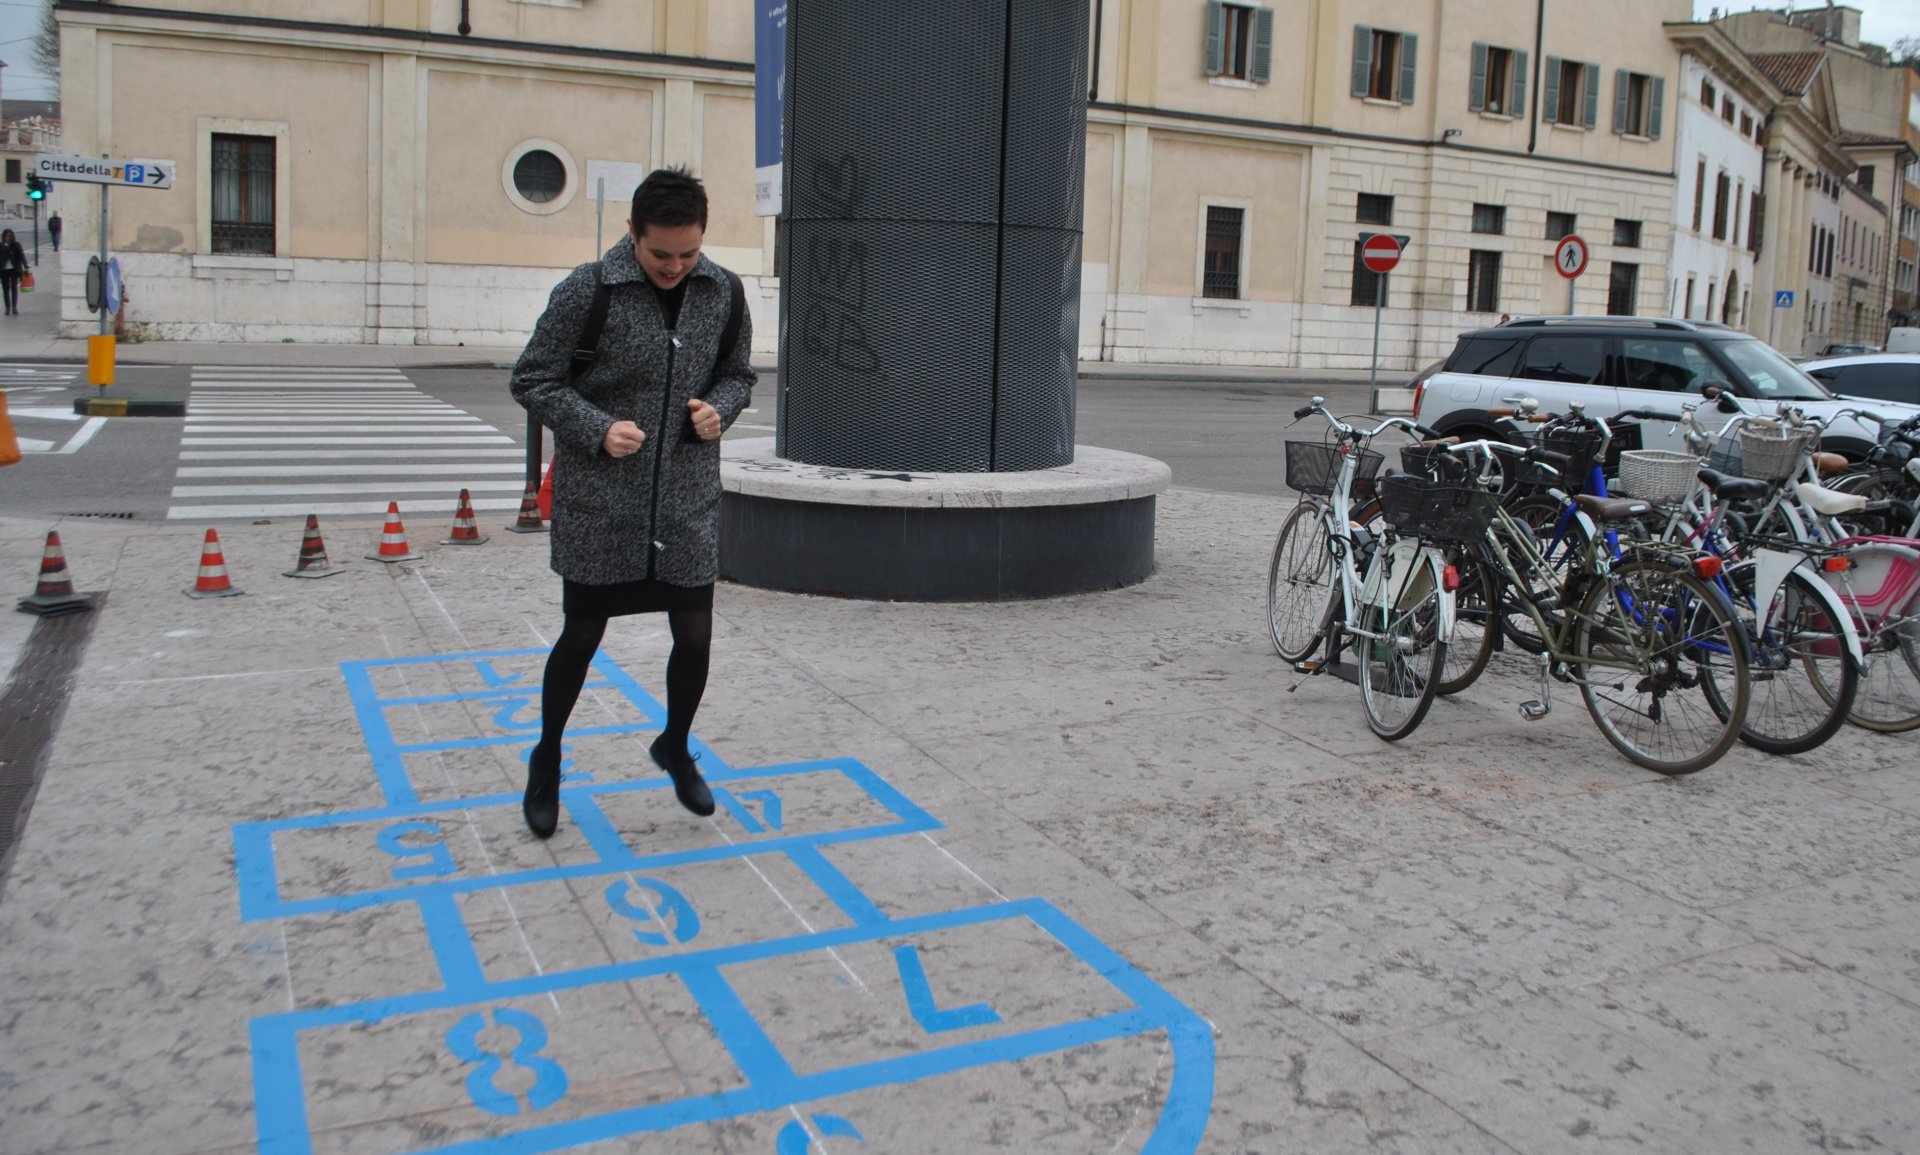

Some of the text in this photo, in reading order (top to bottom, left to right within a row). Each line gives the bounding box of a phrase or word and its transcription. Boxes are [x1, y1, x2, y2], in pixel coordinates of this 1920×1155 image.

[41, 160, 111, 176] Cittadella
[129, 167, 140, 181] P
[474, 661, 523, 687] 1
[482, 698, 542, 730] 2
[709, 787, 783, 834] 4
[376, 821, 457, 881] 5
[605, 877, 701, 948] 6
[891, 944, 1004, 1034] 7
[445, 1008, 569, 1116] 8
